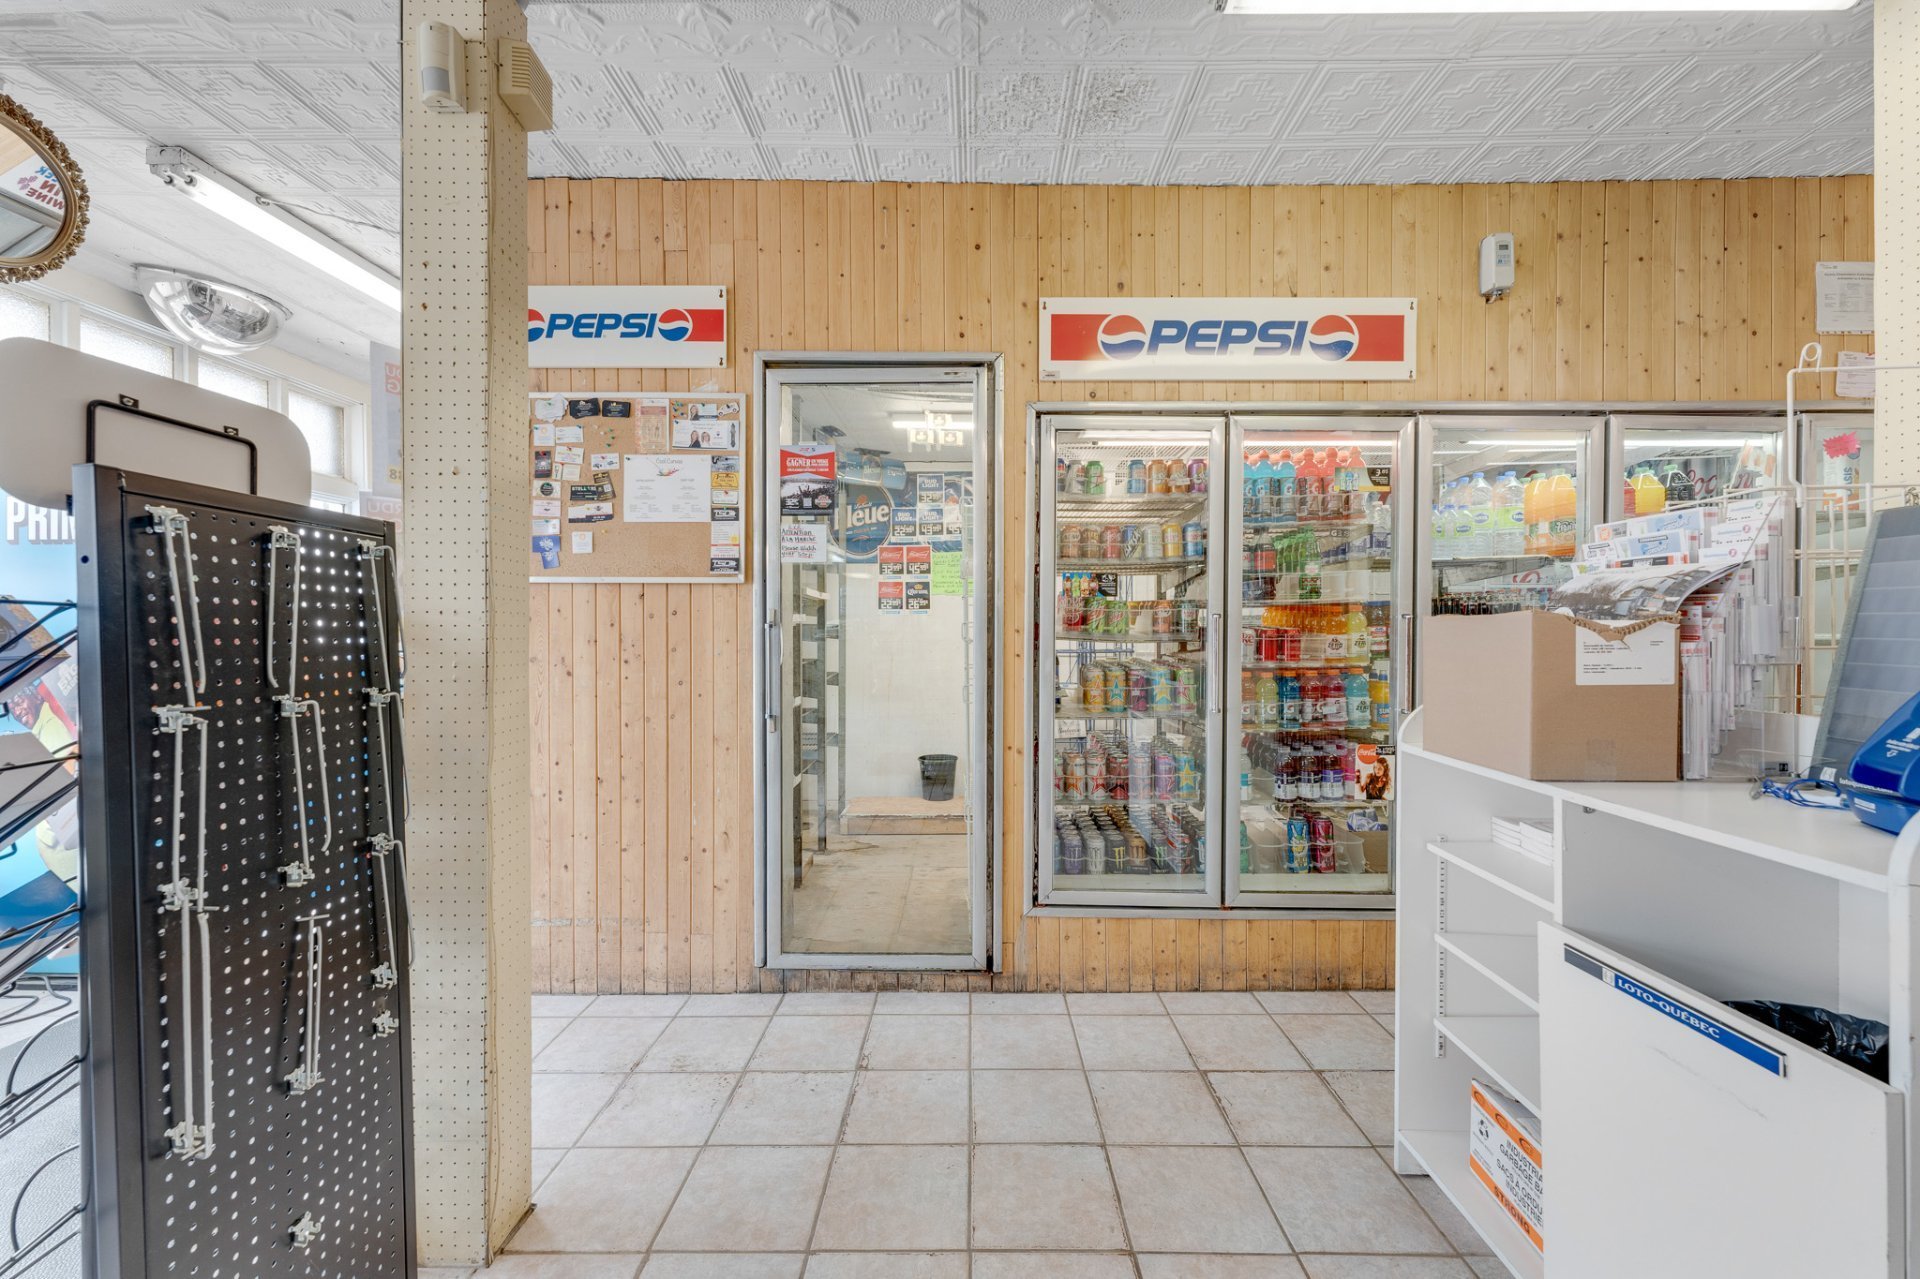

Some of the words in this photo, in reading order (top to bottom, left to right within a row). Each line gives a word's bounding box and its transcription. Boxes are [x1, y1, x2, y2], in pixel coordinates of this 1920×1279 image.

[545, 313, 657, 339] PEPSI
[1147, 320, 1308, 356] PEPSI
[1618, 978, 1721, 1039] LOTO-QUÉBEC
[1494, 1186, 1530, 1235] STRONG
